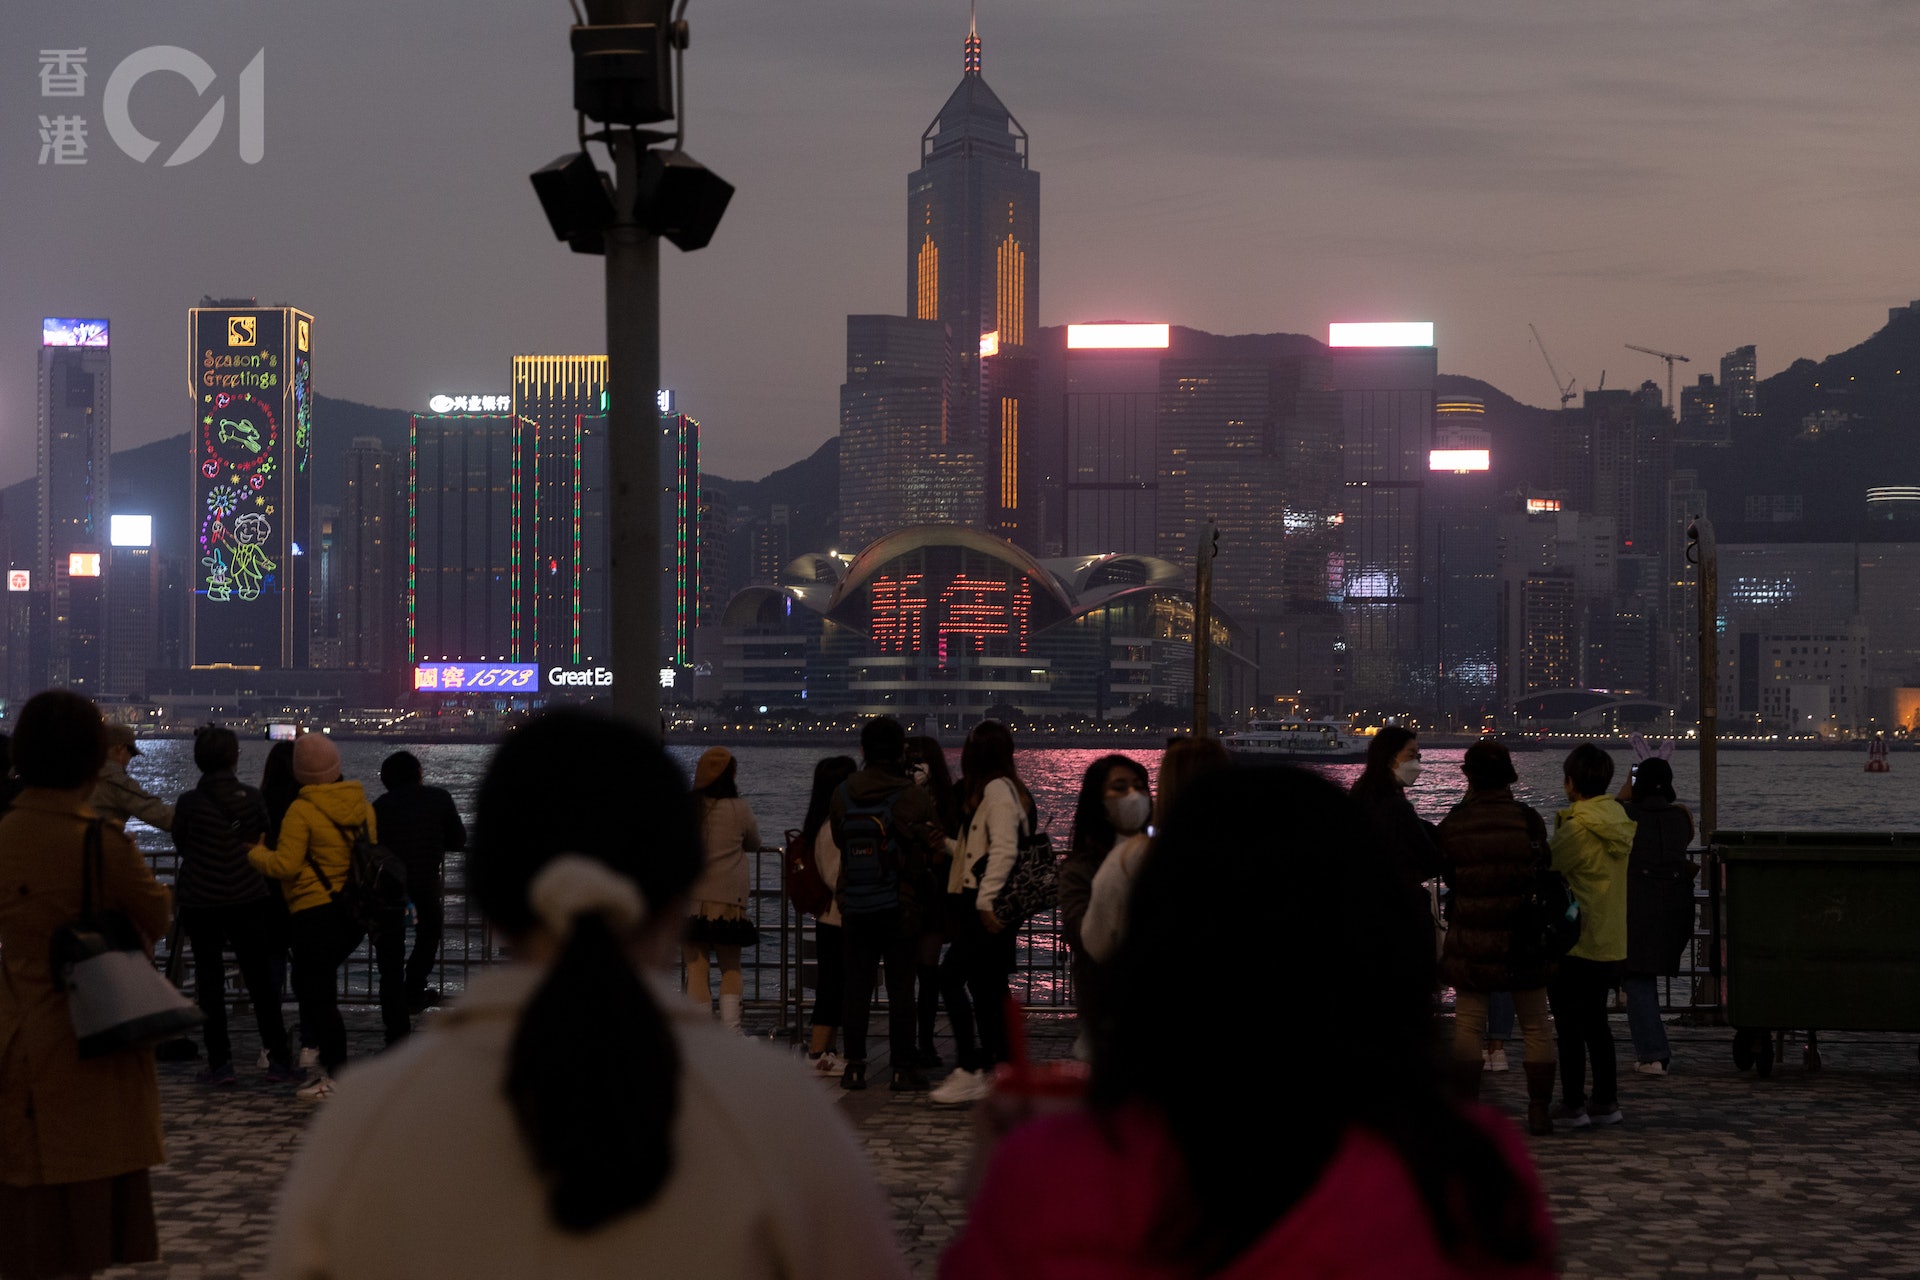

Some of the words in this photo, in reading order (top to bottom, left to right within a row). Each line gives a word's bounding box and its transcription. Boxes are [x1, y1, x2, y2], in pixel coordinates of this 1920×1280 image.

[204, 369, 277, 389] Greetings
[548, 666, 594, 686] Great
[594, 667, 613, 686] Ea
